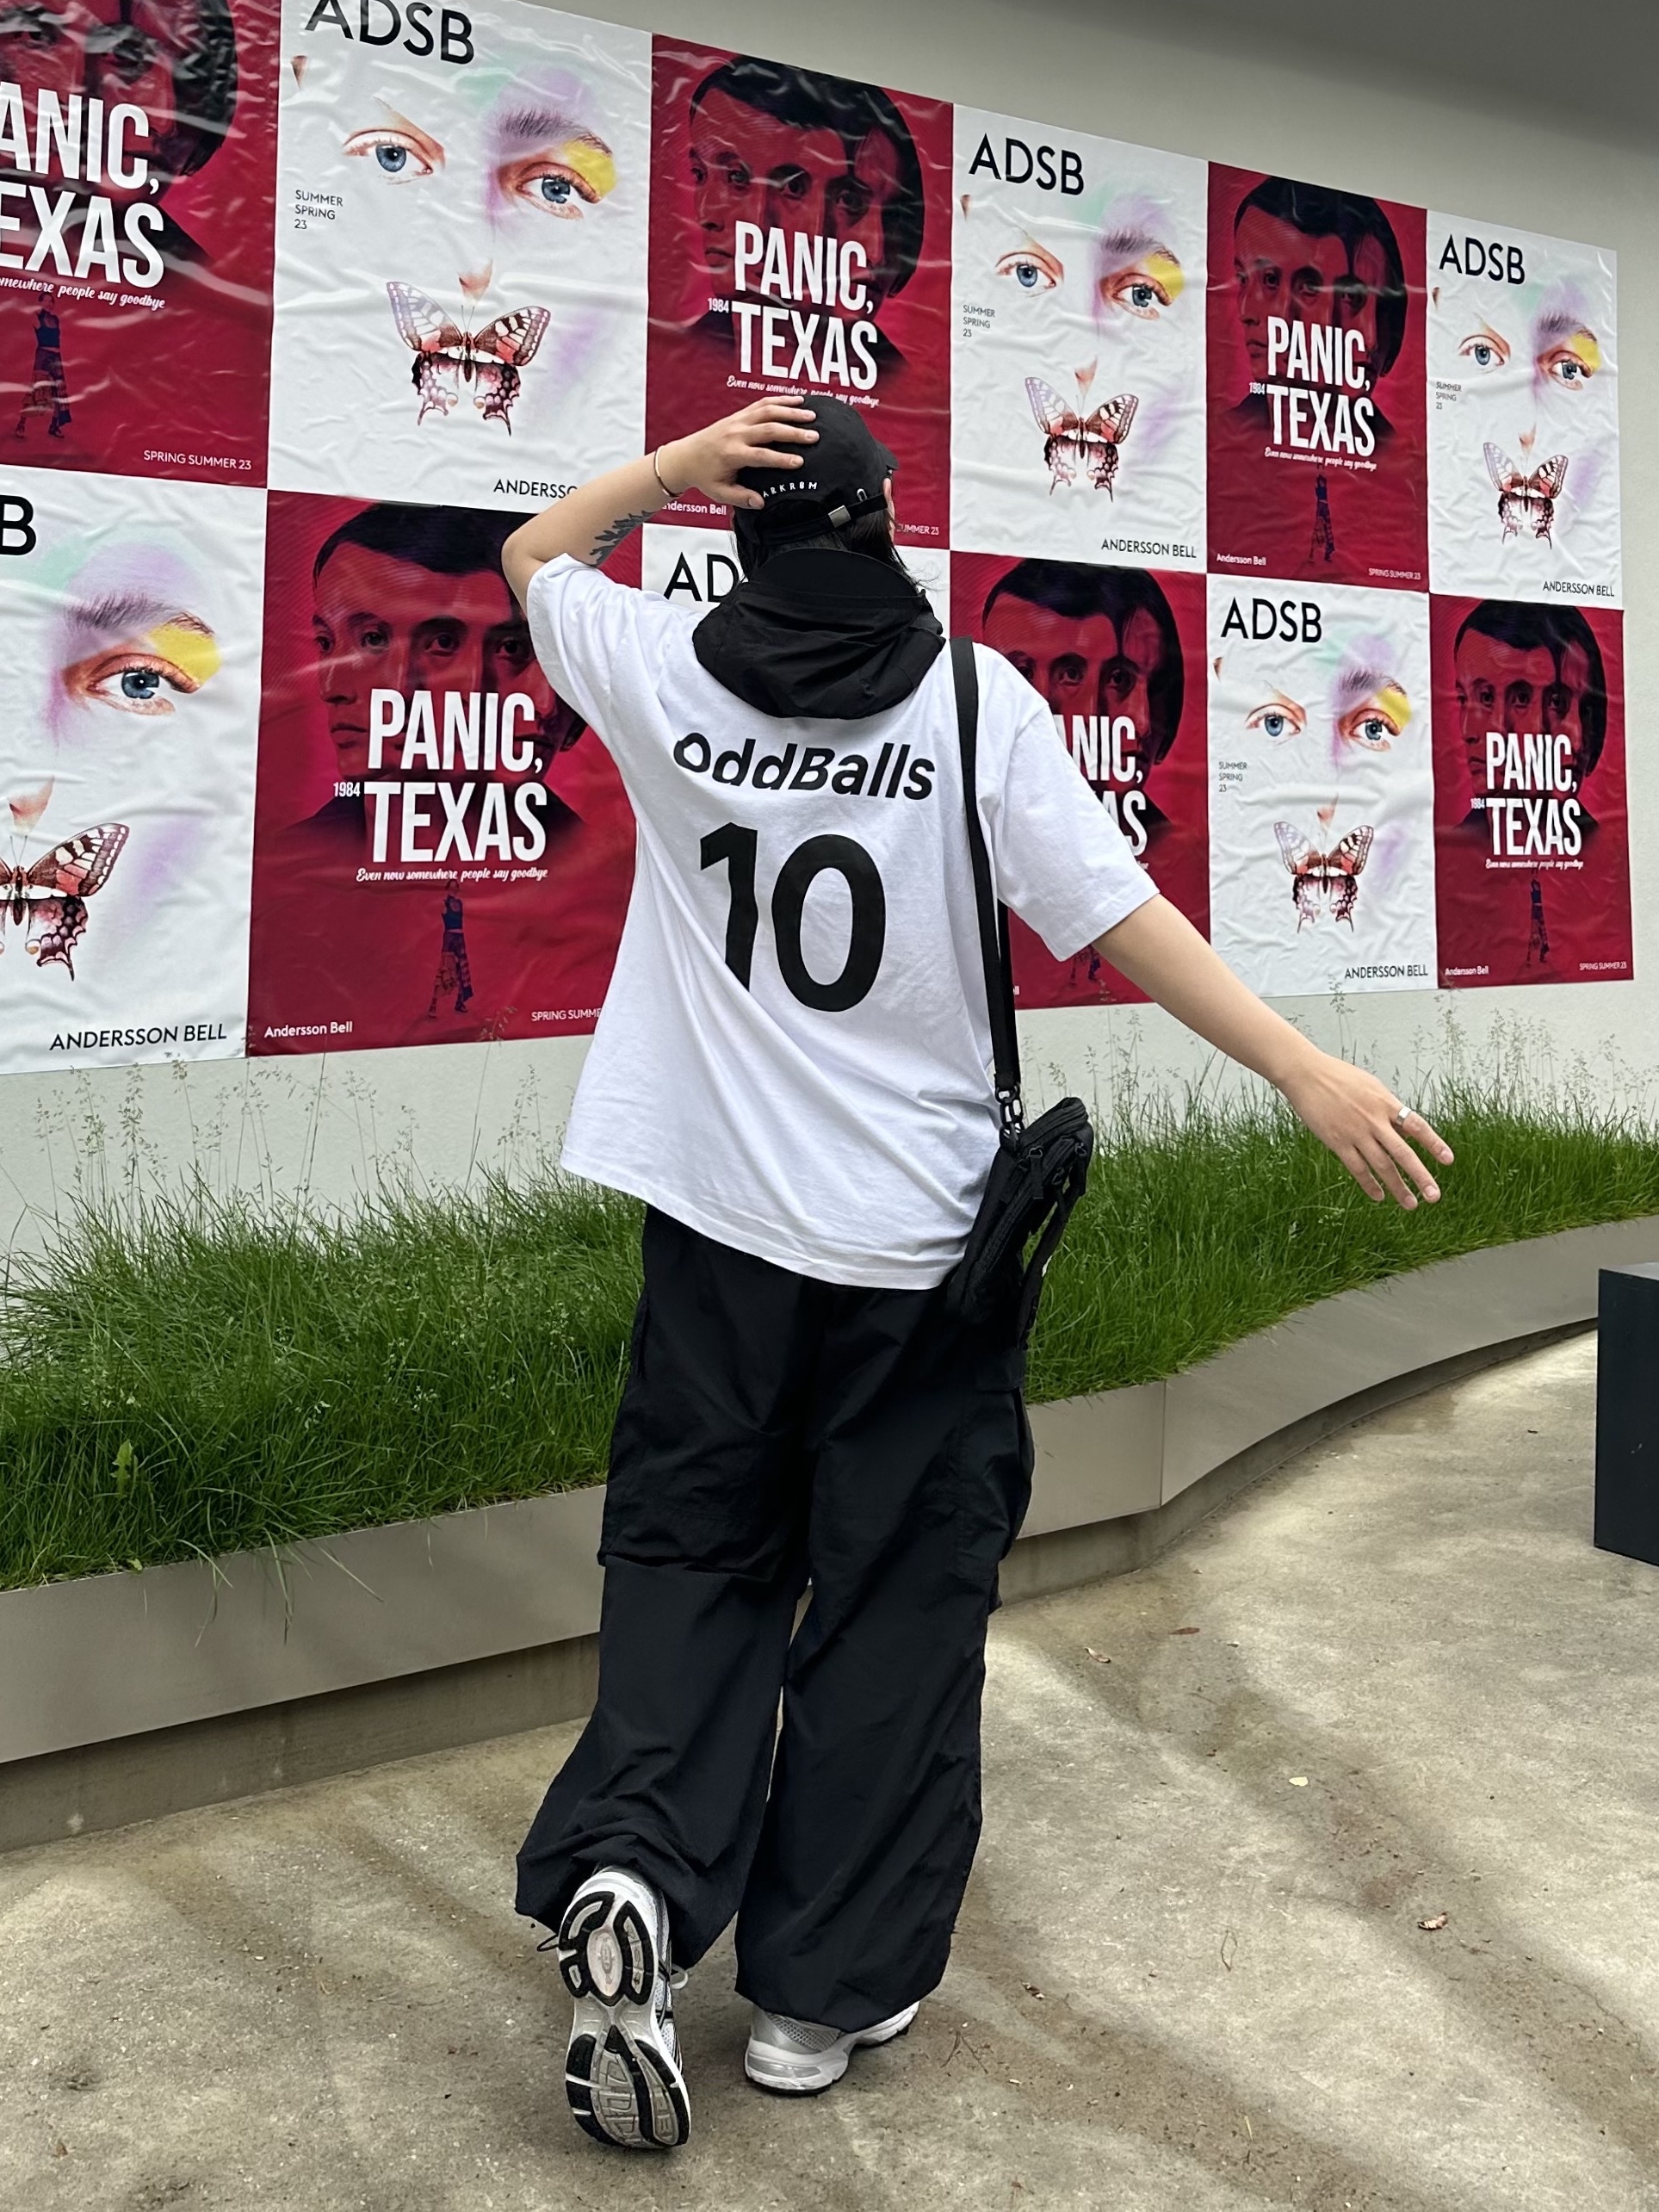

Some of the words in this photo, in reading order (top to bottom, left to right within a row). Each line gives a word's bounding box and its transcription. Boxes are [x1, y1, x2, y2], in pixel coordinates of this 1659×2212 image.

[305, 0, 474, 65] ADSB
[969, 133, 1084, 195] ADSB
[295, 189, 344, 207] SUMMER
[295, 204, 336, 220] SPRING
[294, 219, 307, 229] 23
[734, 220, 874, 313] PANIC,
[1439, 234, 1526, 284] ADSB
[0, 276, 54, 293] mewhere
[57, 285, 96, 300] people
[97, 291, 118, 305] say
[119, 294, 165, 311] goodbye
[707, 298, 729, 313] 1984
[963, 305, 995, 318] SUMMER
[963, 317, 991, 328] SPRING
[963, 328, 972, 338] 23
[731, 301, 878, 391] TEXAS
[1267, 316, 1371, 391] PANIC,
[726, 375, 747, 387] Even
[1266, 384, 1376, 457] TEXAS
[143, 449, 187, 464] SPRING
[188, 455, 237, 468] SUMMER
[238, 460, 252, 470] 23
[709, 504, 727, 516] Bell
[1101, 538, 1170, 555] ANDERSSON
[1172, 544, 1197, 558] BELL
[1543, 580, 1594, 595] ANDERSSON
[1596, 586, 1615, 597] BELL
[1221, 596, 1322, 643] ADSB
[368, 688, 543, 774] PANIC,
[673, 732, 936, 800] OddBalls
[1486, 732, 1577, 792] PANIC,
[333, 781, 361, 797] 1984
[364, 781, 548, 863] TEXAS
[1485, 797, 1582, 856] TEXAS
[356, 867, 382, 883] Even
[383, 871, 405, 881] now
[405, 868, 458, 880] somewhere
[460, 867, 491, 883] people
[492, 869, 510, 882] say
[510, 866, 548, 882] goodbye
[700, 821, 887, 1013] 10
[1345, 965, 1405, 980] ANDERSSON
[1407, 964, 1428, 976] BELL
[531, 1010, 566, 1021] SPRING
[49, 1026, 178, 1050] ANDERSSON
[183, 1023, 227, 1042] BELL
[263, 1024, 327, 1038] Andersson
[330, 1020, 353, 1033] Bell
